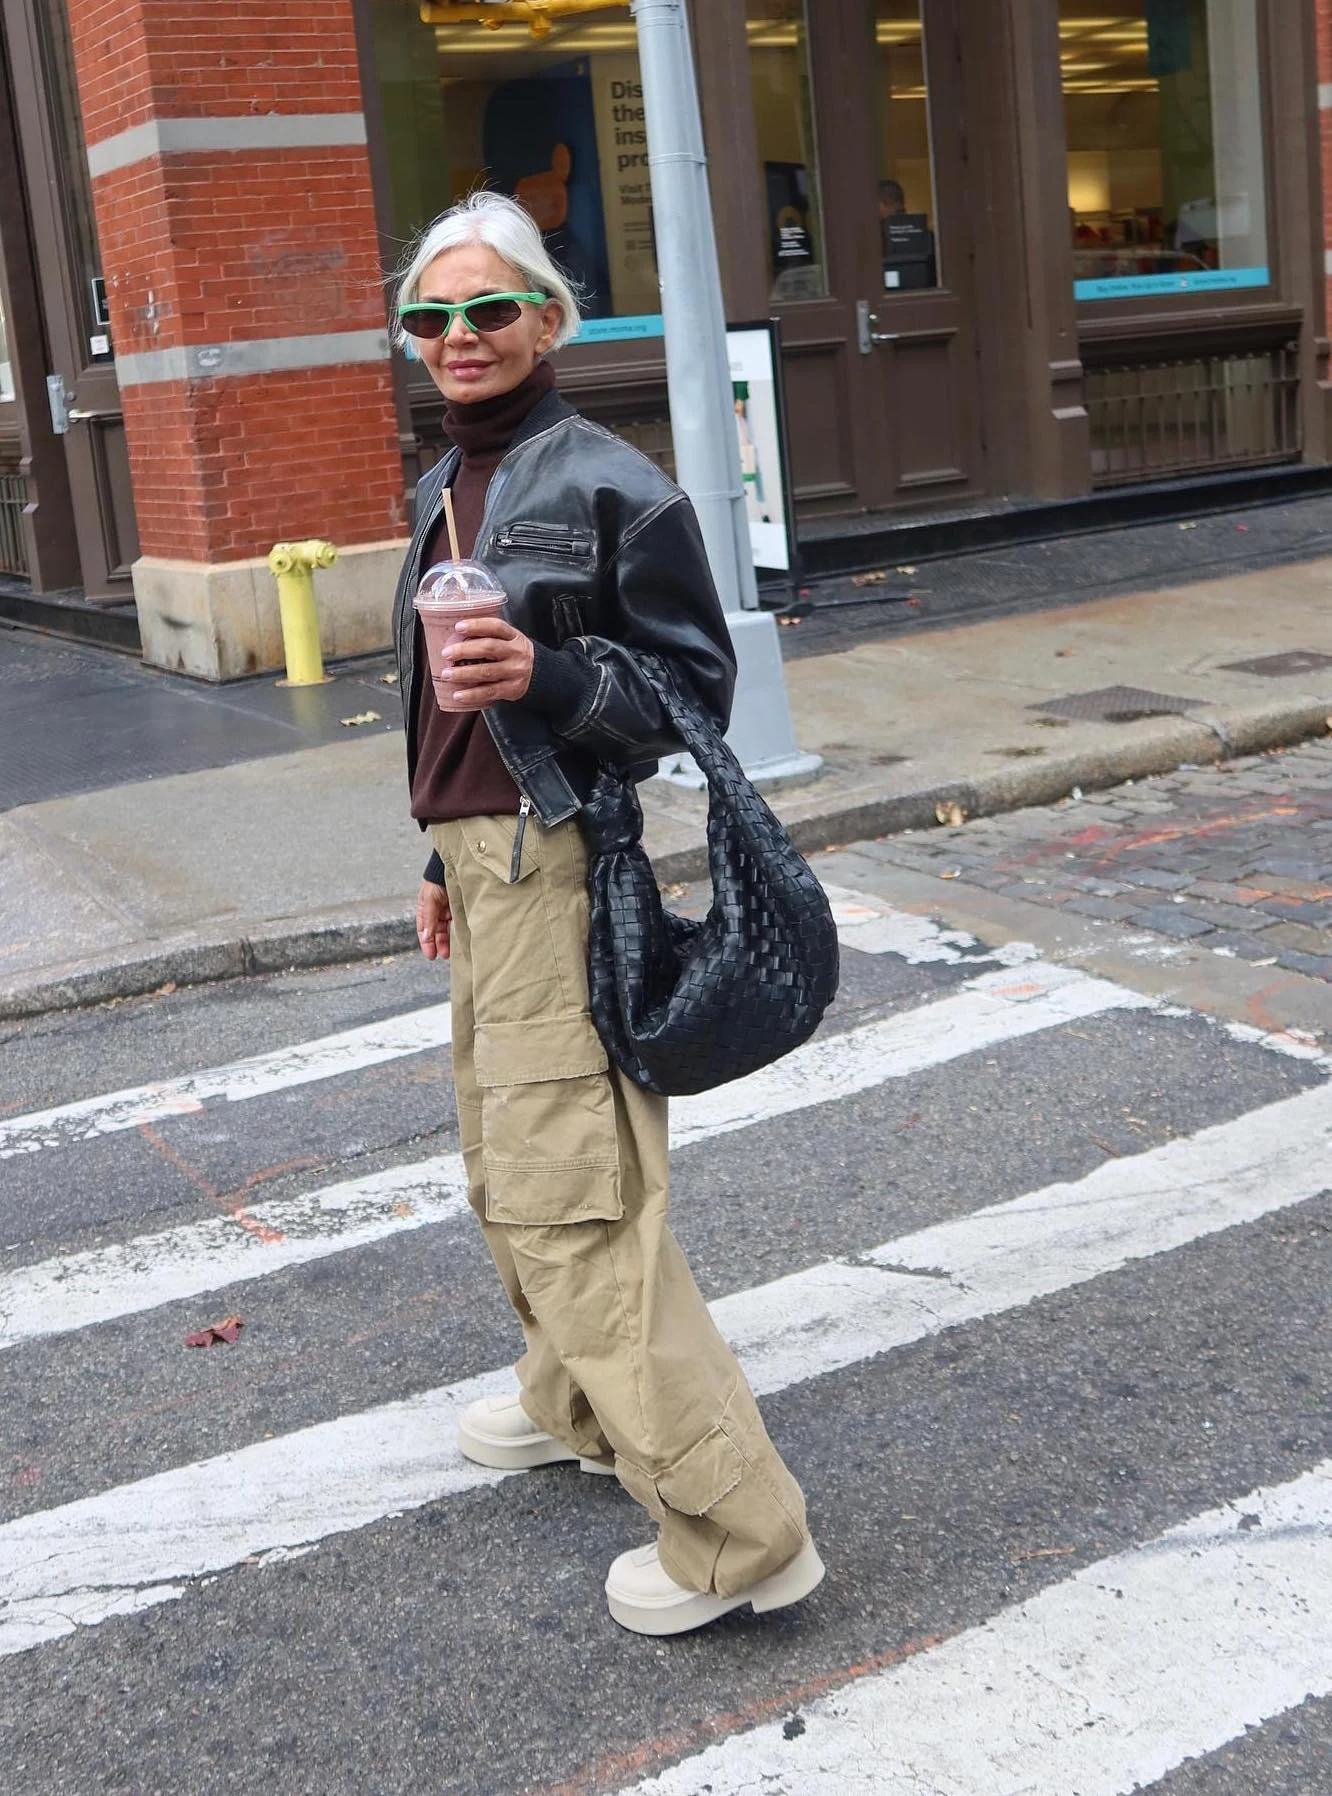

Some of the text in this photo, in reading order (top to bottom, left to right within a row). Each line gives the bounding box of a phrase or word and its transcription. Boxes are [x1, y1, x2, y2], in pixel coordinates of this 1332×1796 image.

[611, 81, 643, 99] Dis
[612, 104, 645, 122] the
[615, 128, 647, 145] ins
